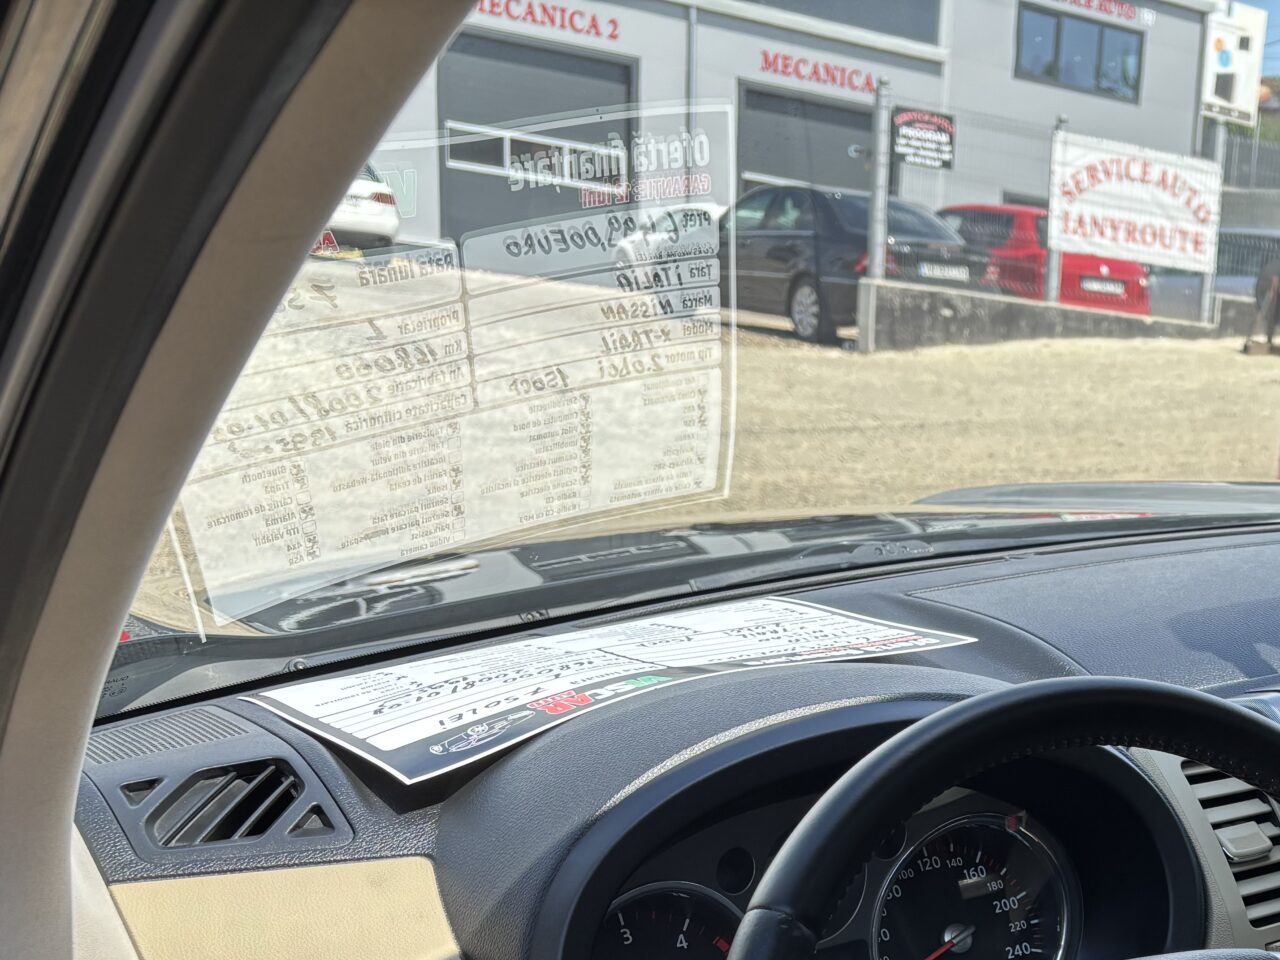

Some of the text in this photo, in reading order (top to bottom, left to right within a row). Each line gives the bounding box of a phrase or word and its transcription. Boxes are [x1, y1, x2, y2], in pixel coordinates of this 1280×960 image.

[607, 18, 619, 39] 2
[760, 49, 876, 93] MECANICA
[1061, 157, 1212, 224] SERVICE AUTO
[917, 856, 941, 872] 120
[946, 857, 963, 869] 140
[963, 865, 987, 881] 160
[986, 880, 1004, 892] 180
[993, 897, 1018, 914] 200
[1009, 920, 1027, 932] 220
[620, 928, 633, 945] 3
[676, 934, 688, 950] 4
[1005, 942, 1031, 959] 240
